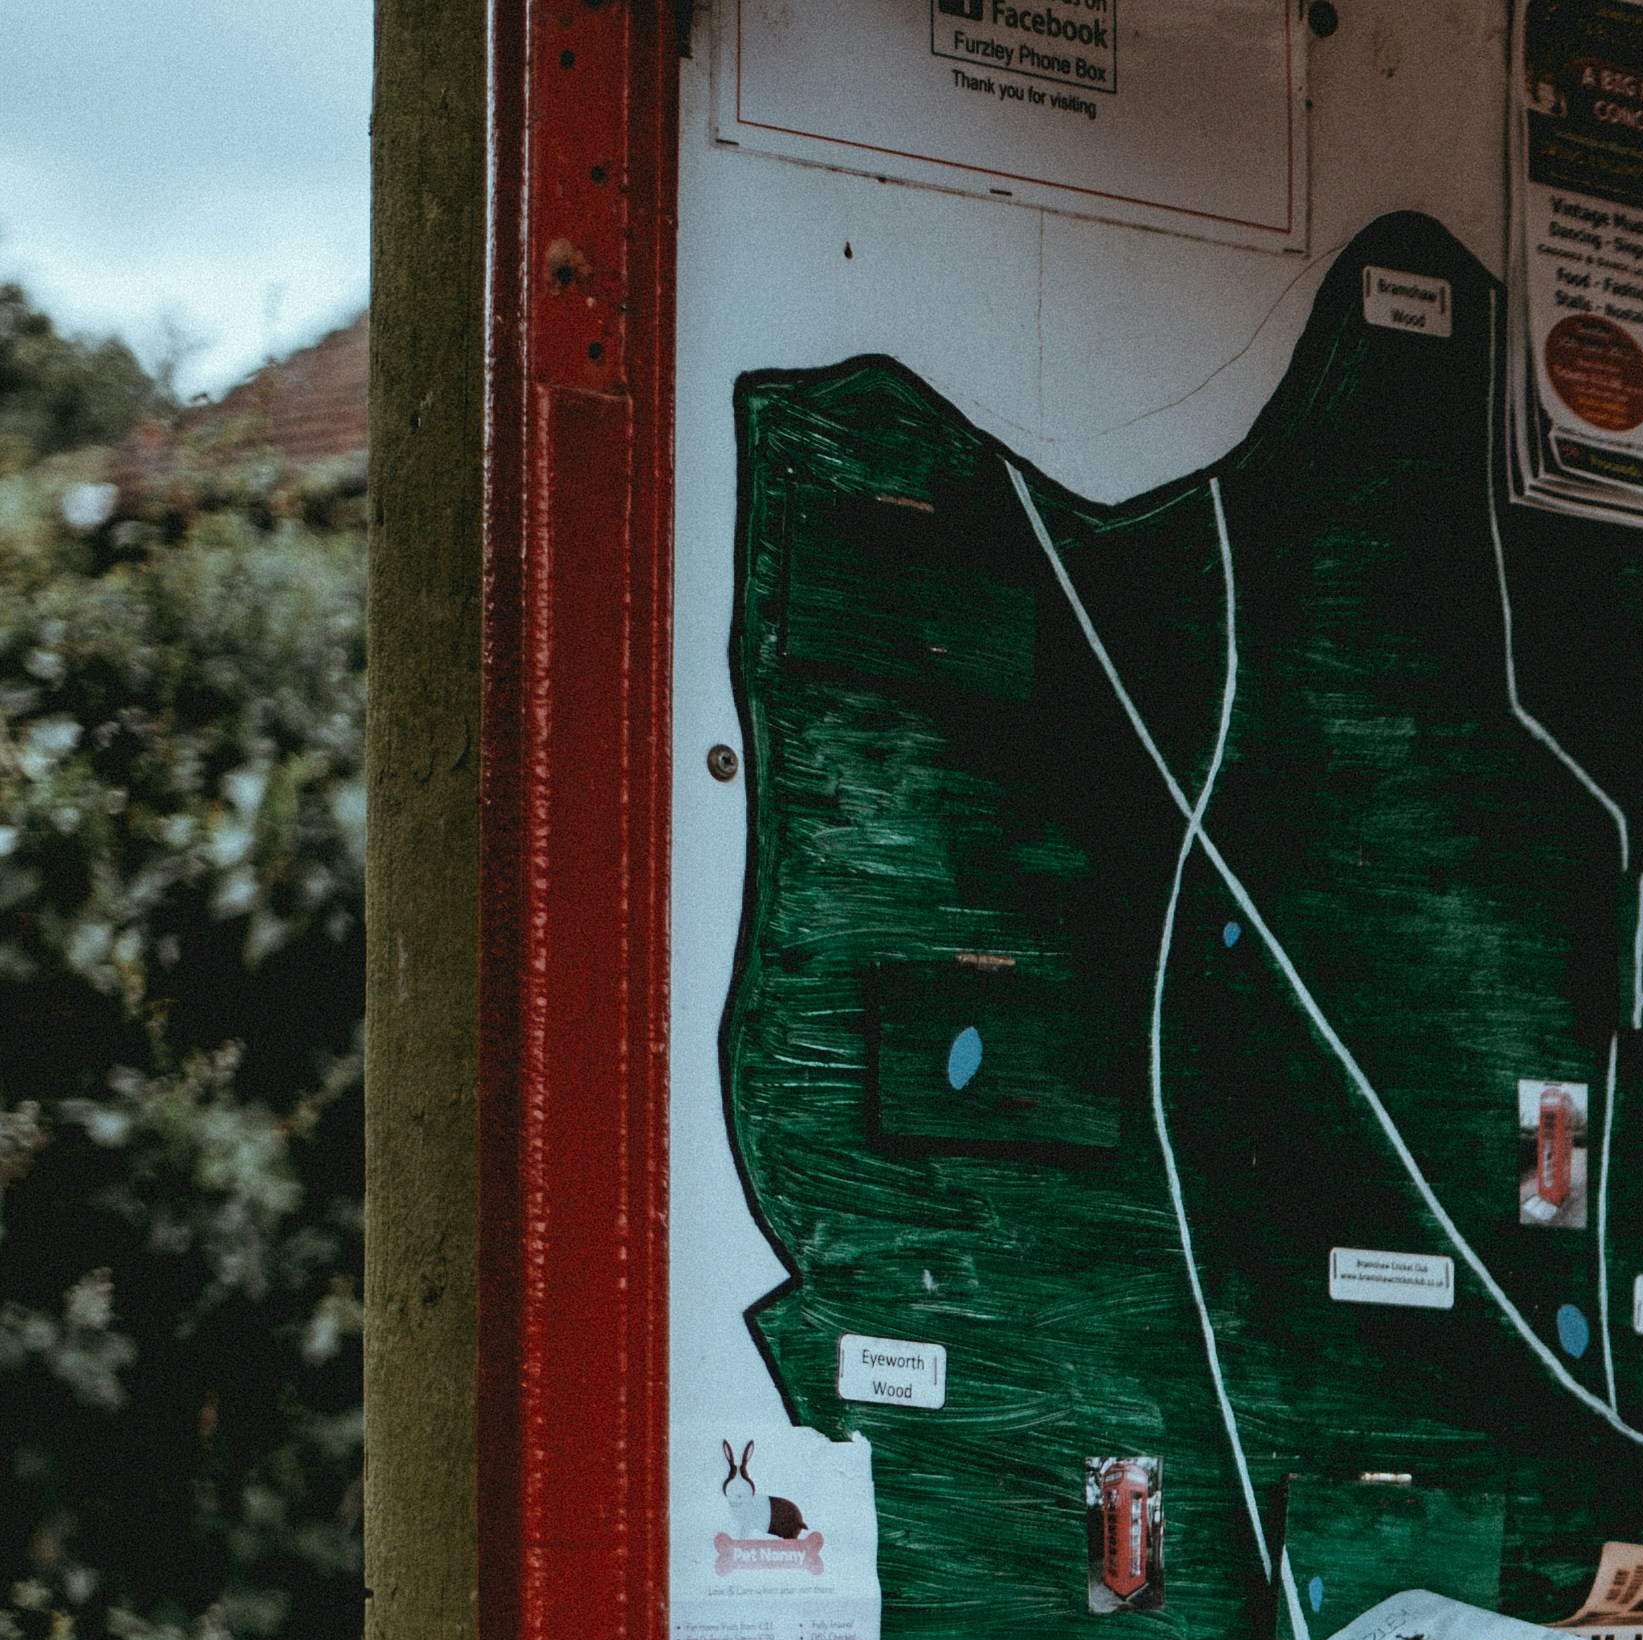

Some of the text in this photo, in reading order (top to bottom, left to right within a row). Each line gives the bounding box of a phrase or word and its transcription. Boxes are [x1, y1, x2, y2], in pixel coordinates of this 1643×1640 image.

[992, 0, 1108, 48] Facebook
[954, 30, 1107, 82] Furzley Phone Box
[951, 69, 1097, 120] Thank you for visiting
[862, 1349, 925, 1370] Eyeworth
[873, 1381, 912, 1398] Wood
[733, 1547, 807, 1568] Pet Nanny
